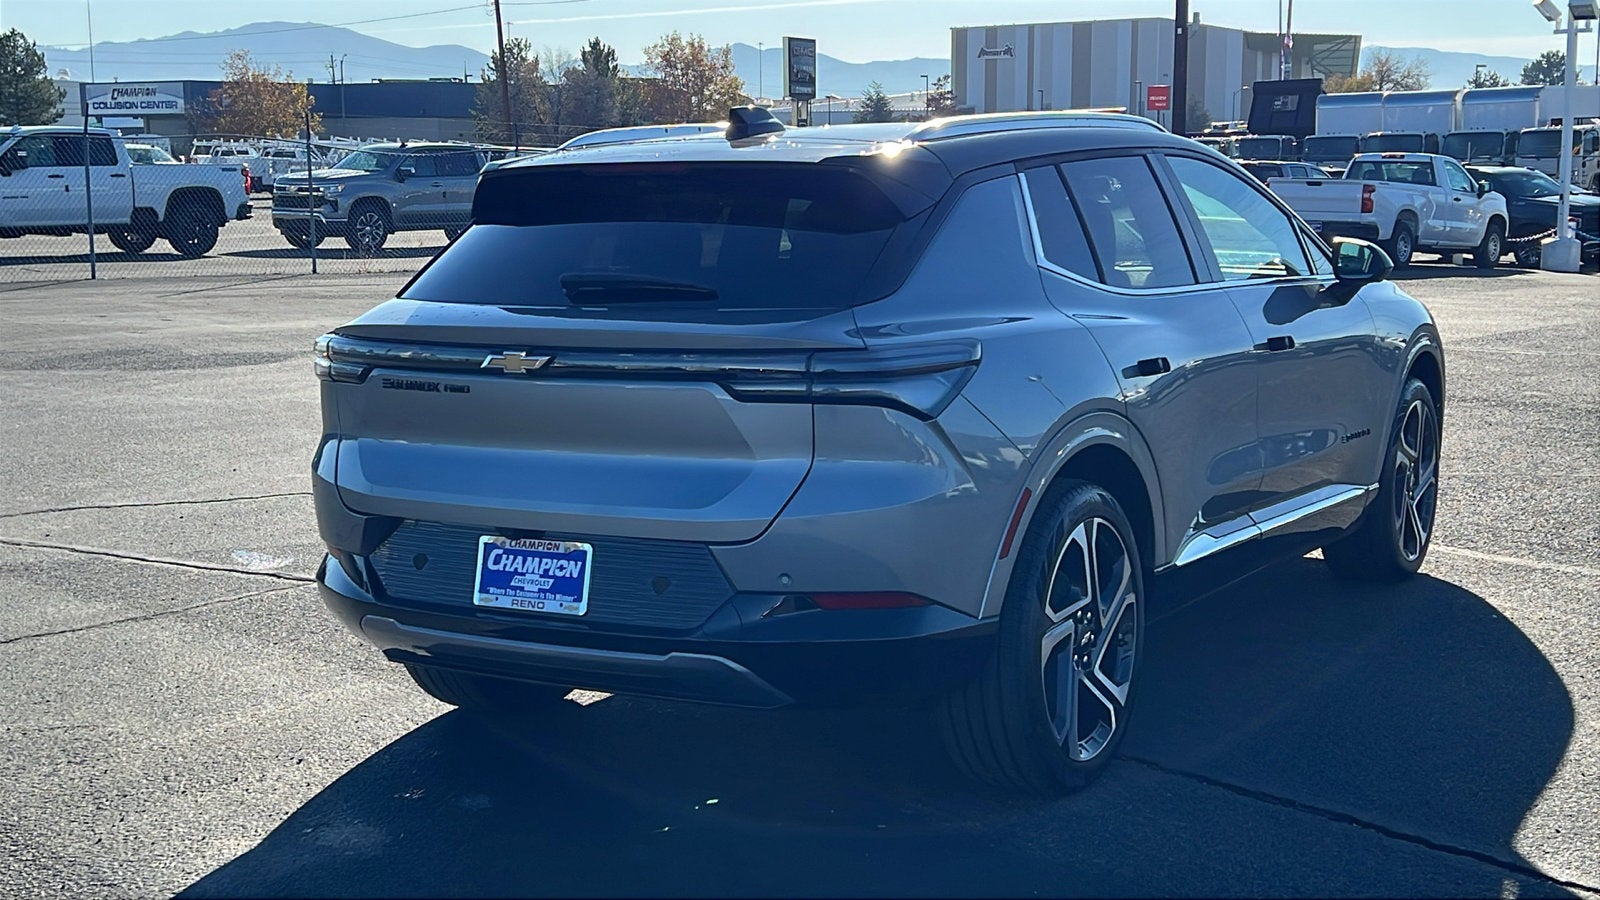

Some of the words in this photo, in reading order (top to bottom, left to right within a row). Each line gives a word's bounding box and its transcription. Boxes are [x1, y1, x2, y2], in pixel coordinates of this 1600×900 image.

[111, 87, 157, 100] CHAMPION
[92, 101, 138, 110] COLLISION
[140, 100, 178, 109] CENTER
[509, 539, 560, 552] CHAMPION
[487, 548, 582, 578] CHAMPION
[513, 576, 551, 588] CHEVROLET
[511, 599, 546, 610] RENO
